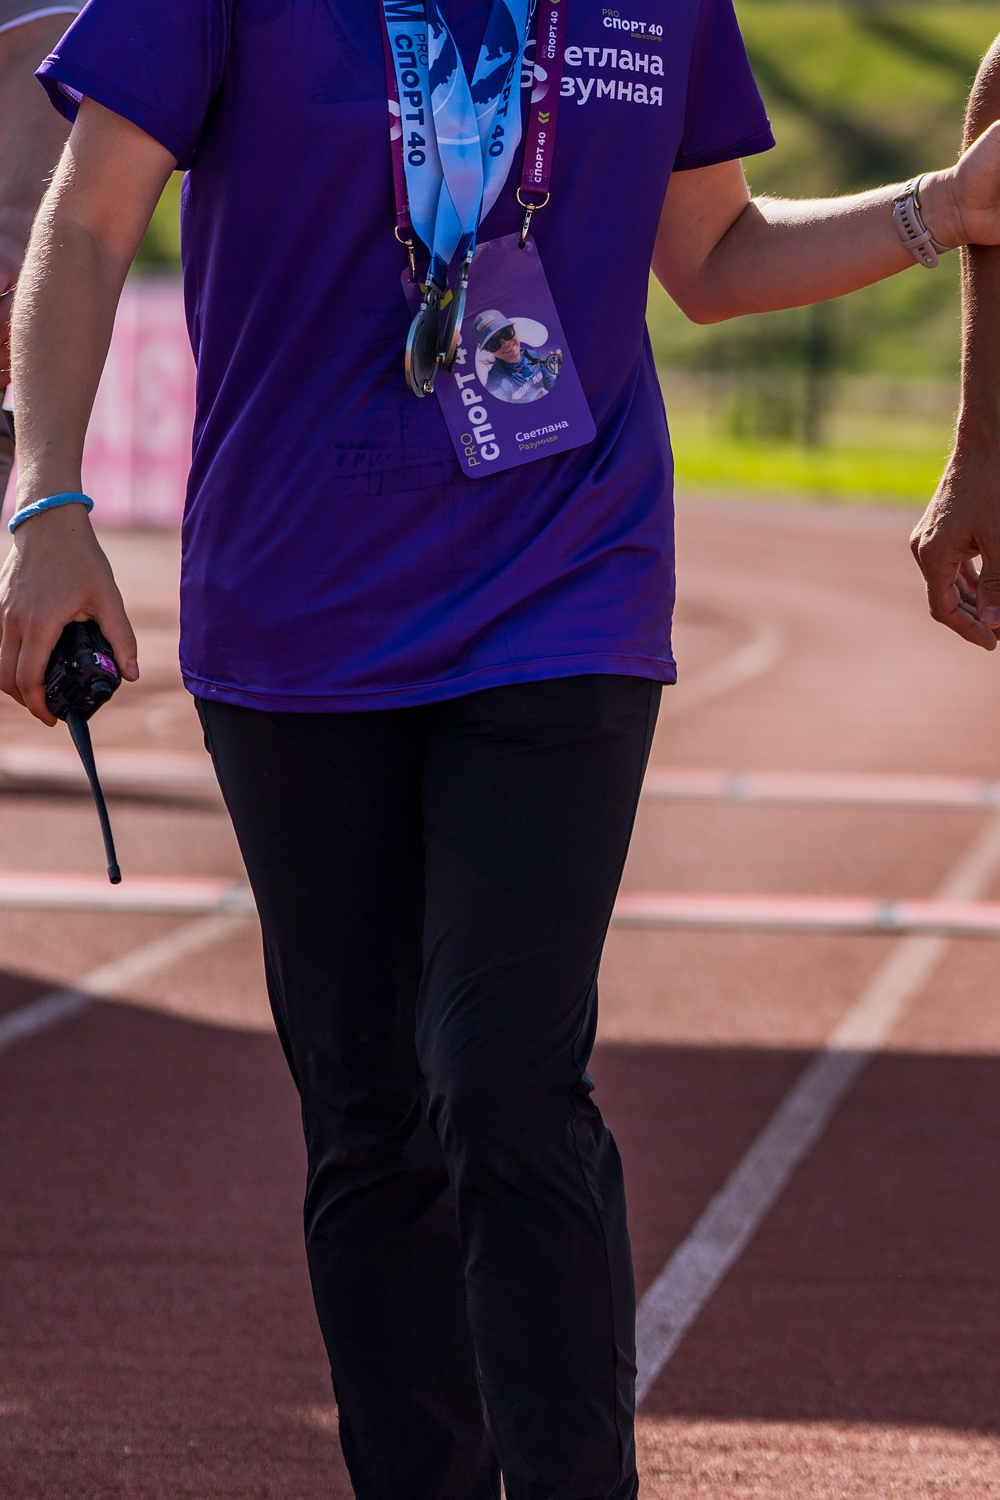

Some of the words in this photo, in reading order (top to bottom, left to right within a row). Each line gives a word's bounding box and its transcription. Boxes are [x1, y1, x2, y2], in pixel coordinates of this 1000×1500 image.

[550, 11, 558, 24] 40
[602, 9, 619, 17] PRO
[603, 17, 646, 33] СПОРТ
[649, 24, 663, 36] 40
[414, 33, 428, 66] PRO
[547, 25, 557, 59] СПОРТ
[394, 34, 425, 125] СПОРТ
[407, 131, 426, 167] 40
[488, 124, 504, 157] 40
[537, 131, 546, 145] 40
[534, 147, 545, 183] СПОРТ
[455, 369, 500, 461] СПОРТ
[515, 420, 569, 442] Светлана
[461, 433, 481, 467] PRO
[518, 435, 558, 451] Разумная
